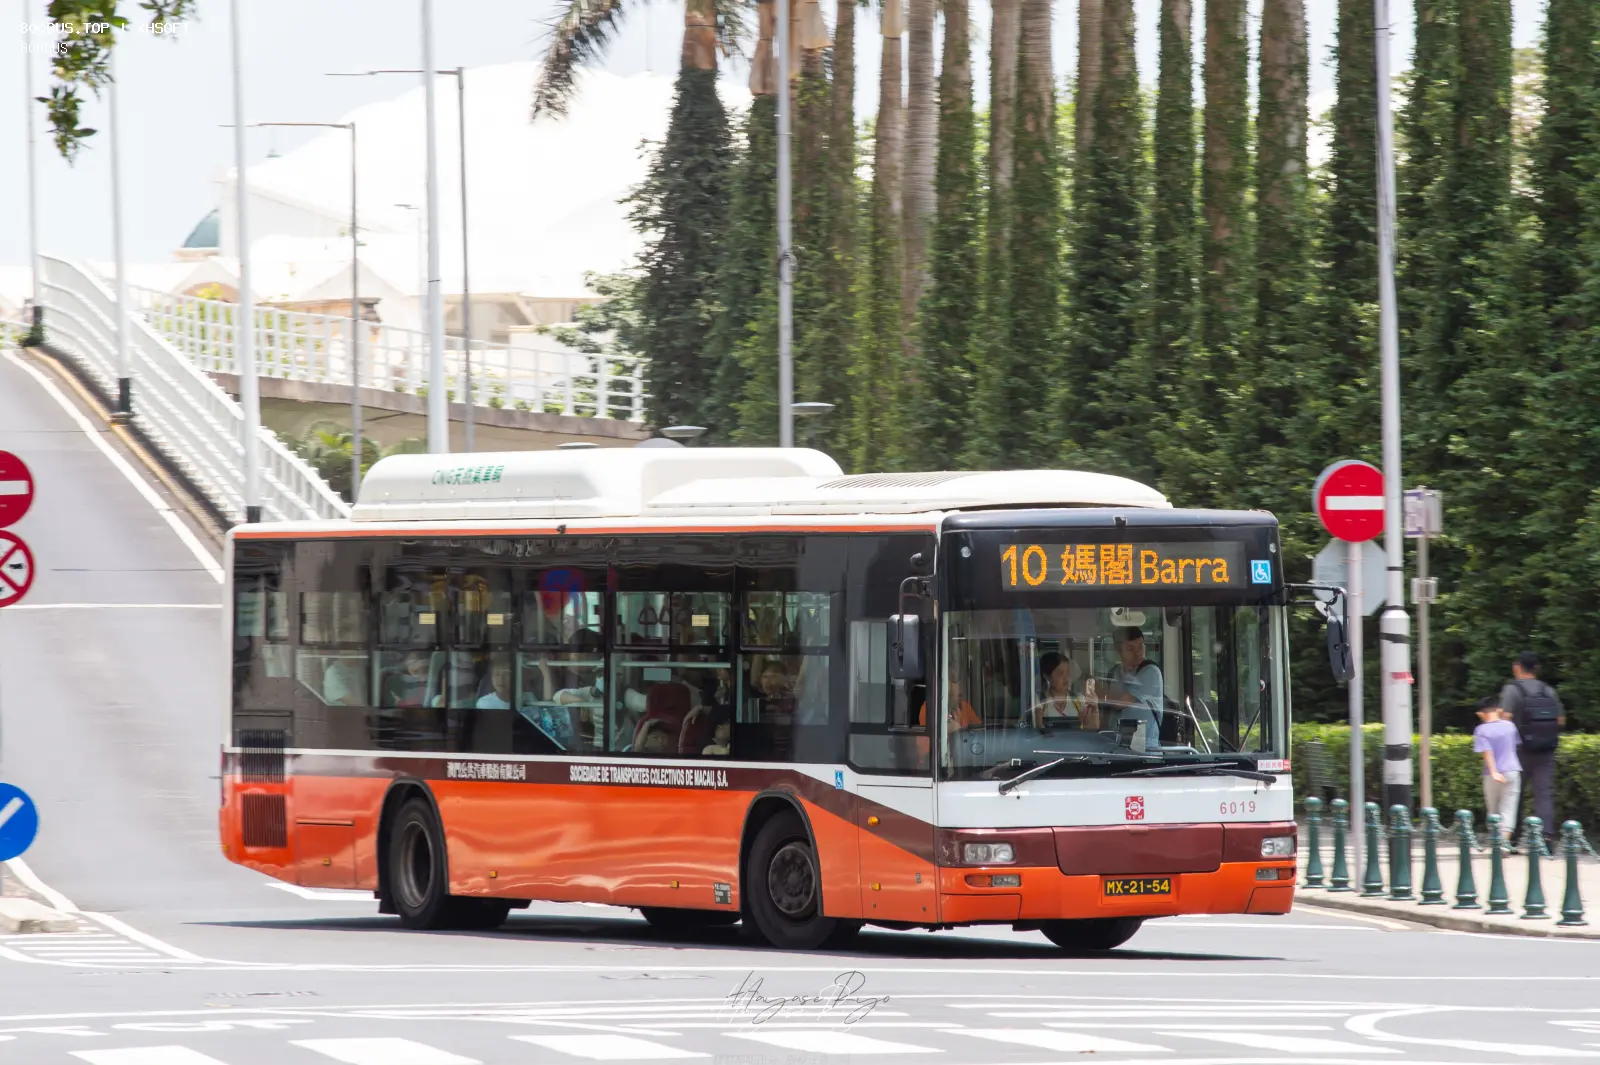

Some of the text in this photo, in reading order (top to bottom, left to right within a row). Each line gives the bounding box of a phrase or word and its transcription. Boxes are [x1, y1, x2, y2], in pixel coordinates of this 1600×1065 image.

[1002, 544, 1230, 586] 10 媽閣 Barra
[569, 765, 729, 789] SOCIEDADE DE TRANSPORTES COLECTIVOS DE MACAU, S.A.
[1219, 801, 1256, 815] 6019
[1106, 879, 1170, 895] MX-21-54
